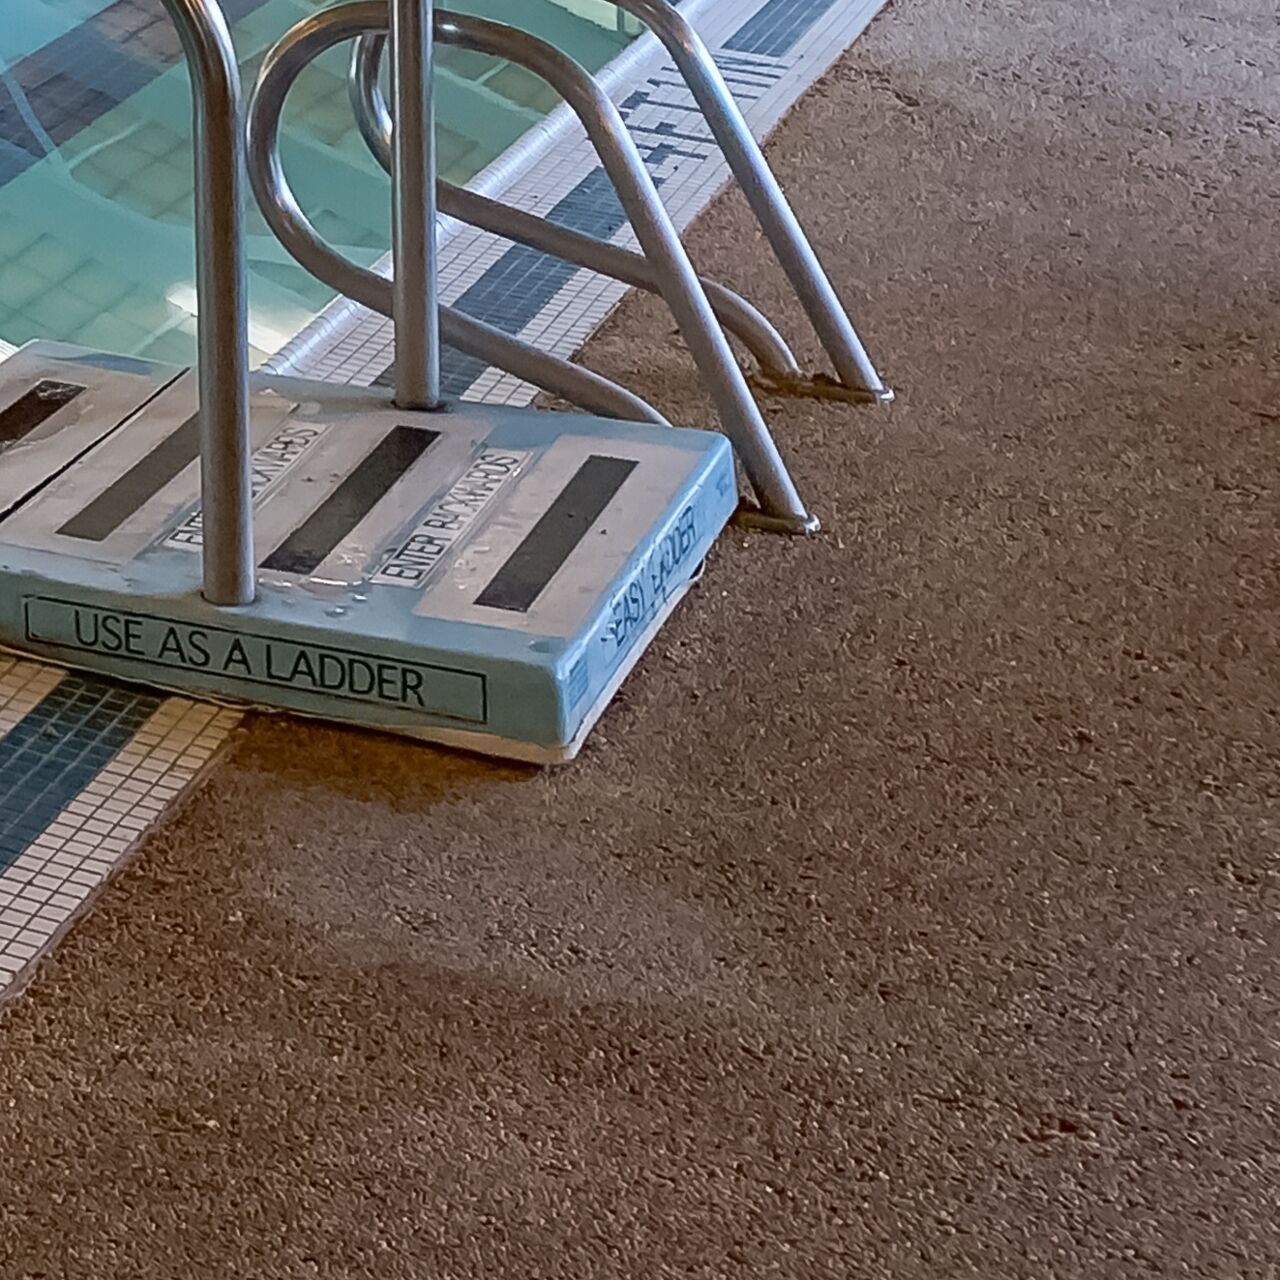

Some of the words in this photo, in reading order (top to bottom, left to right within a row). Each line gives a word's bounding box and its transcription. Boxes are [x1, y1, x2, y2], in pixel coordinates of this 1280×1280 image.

[380, 533, 463, 580] ENTER
[73, 608, 145, 657] USE
[157, 627, 211, 669] AS
[223, 639, 251, 678] A
[265, 644, 425, 707] LADDER
